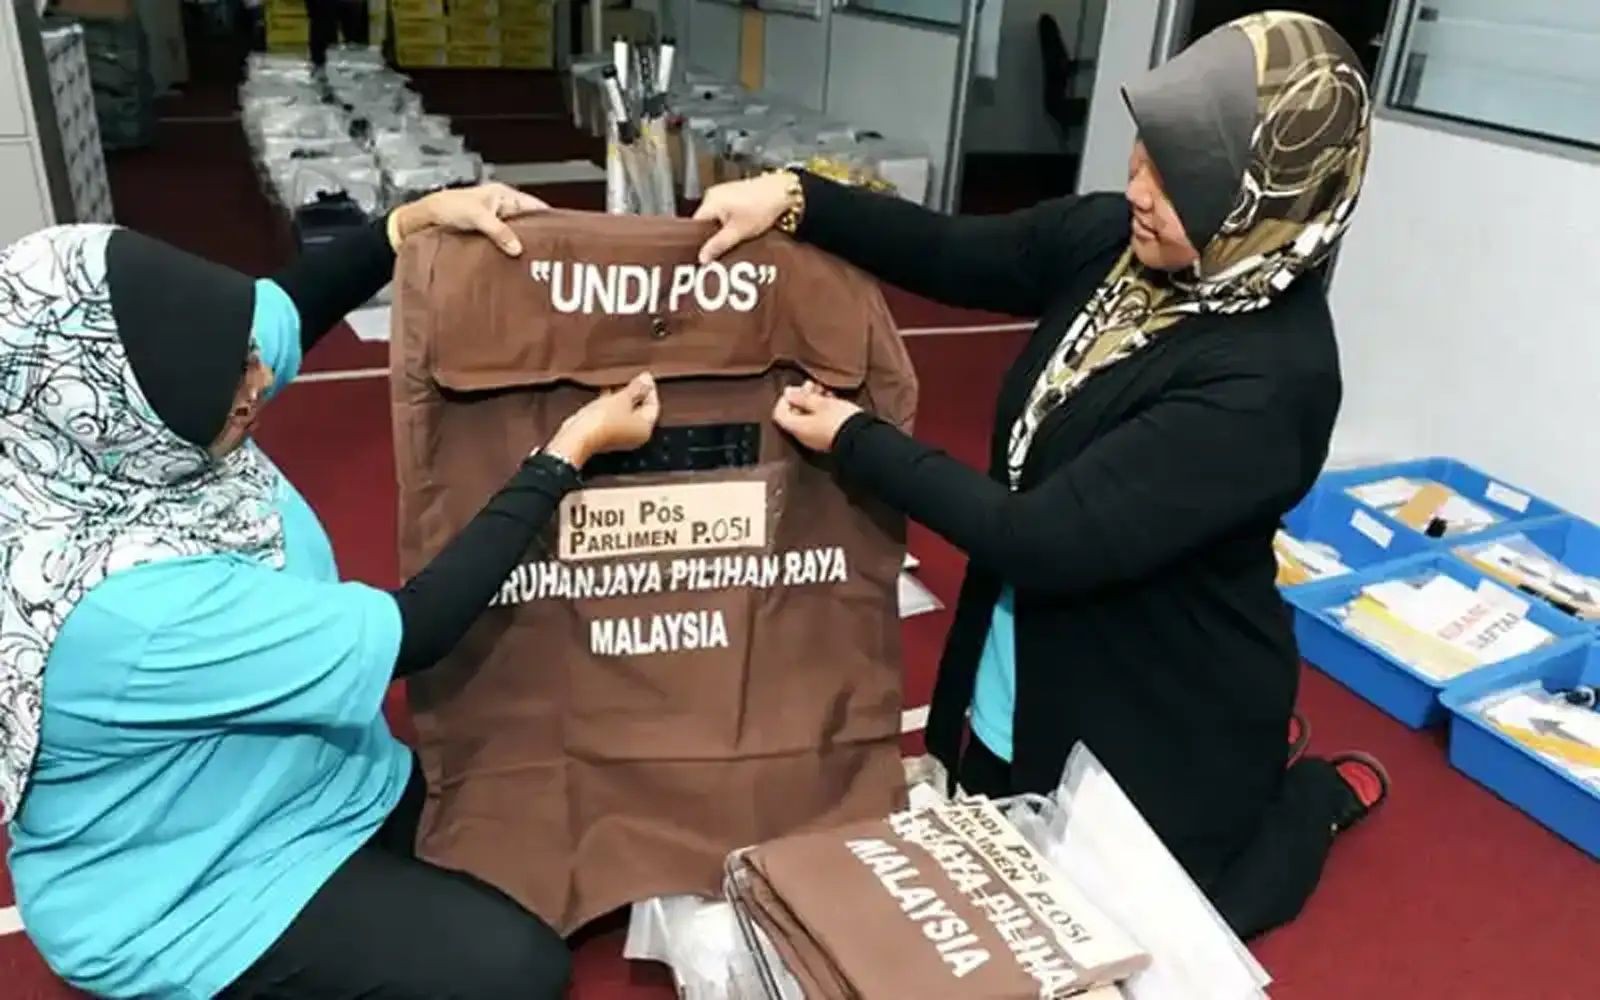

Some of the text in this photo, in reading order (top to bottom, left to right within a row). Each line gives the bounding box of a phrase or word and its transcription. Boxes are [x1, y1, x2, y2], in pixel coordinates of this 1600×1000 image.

[488, 547, 848, 607] RUHANJAYA PILIHAN RAYA
[590, 611, 729, 657] MALAYSIA
[845, 837, 990, 978] MALAYSIA
